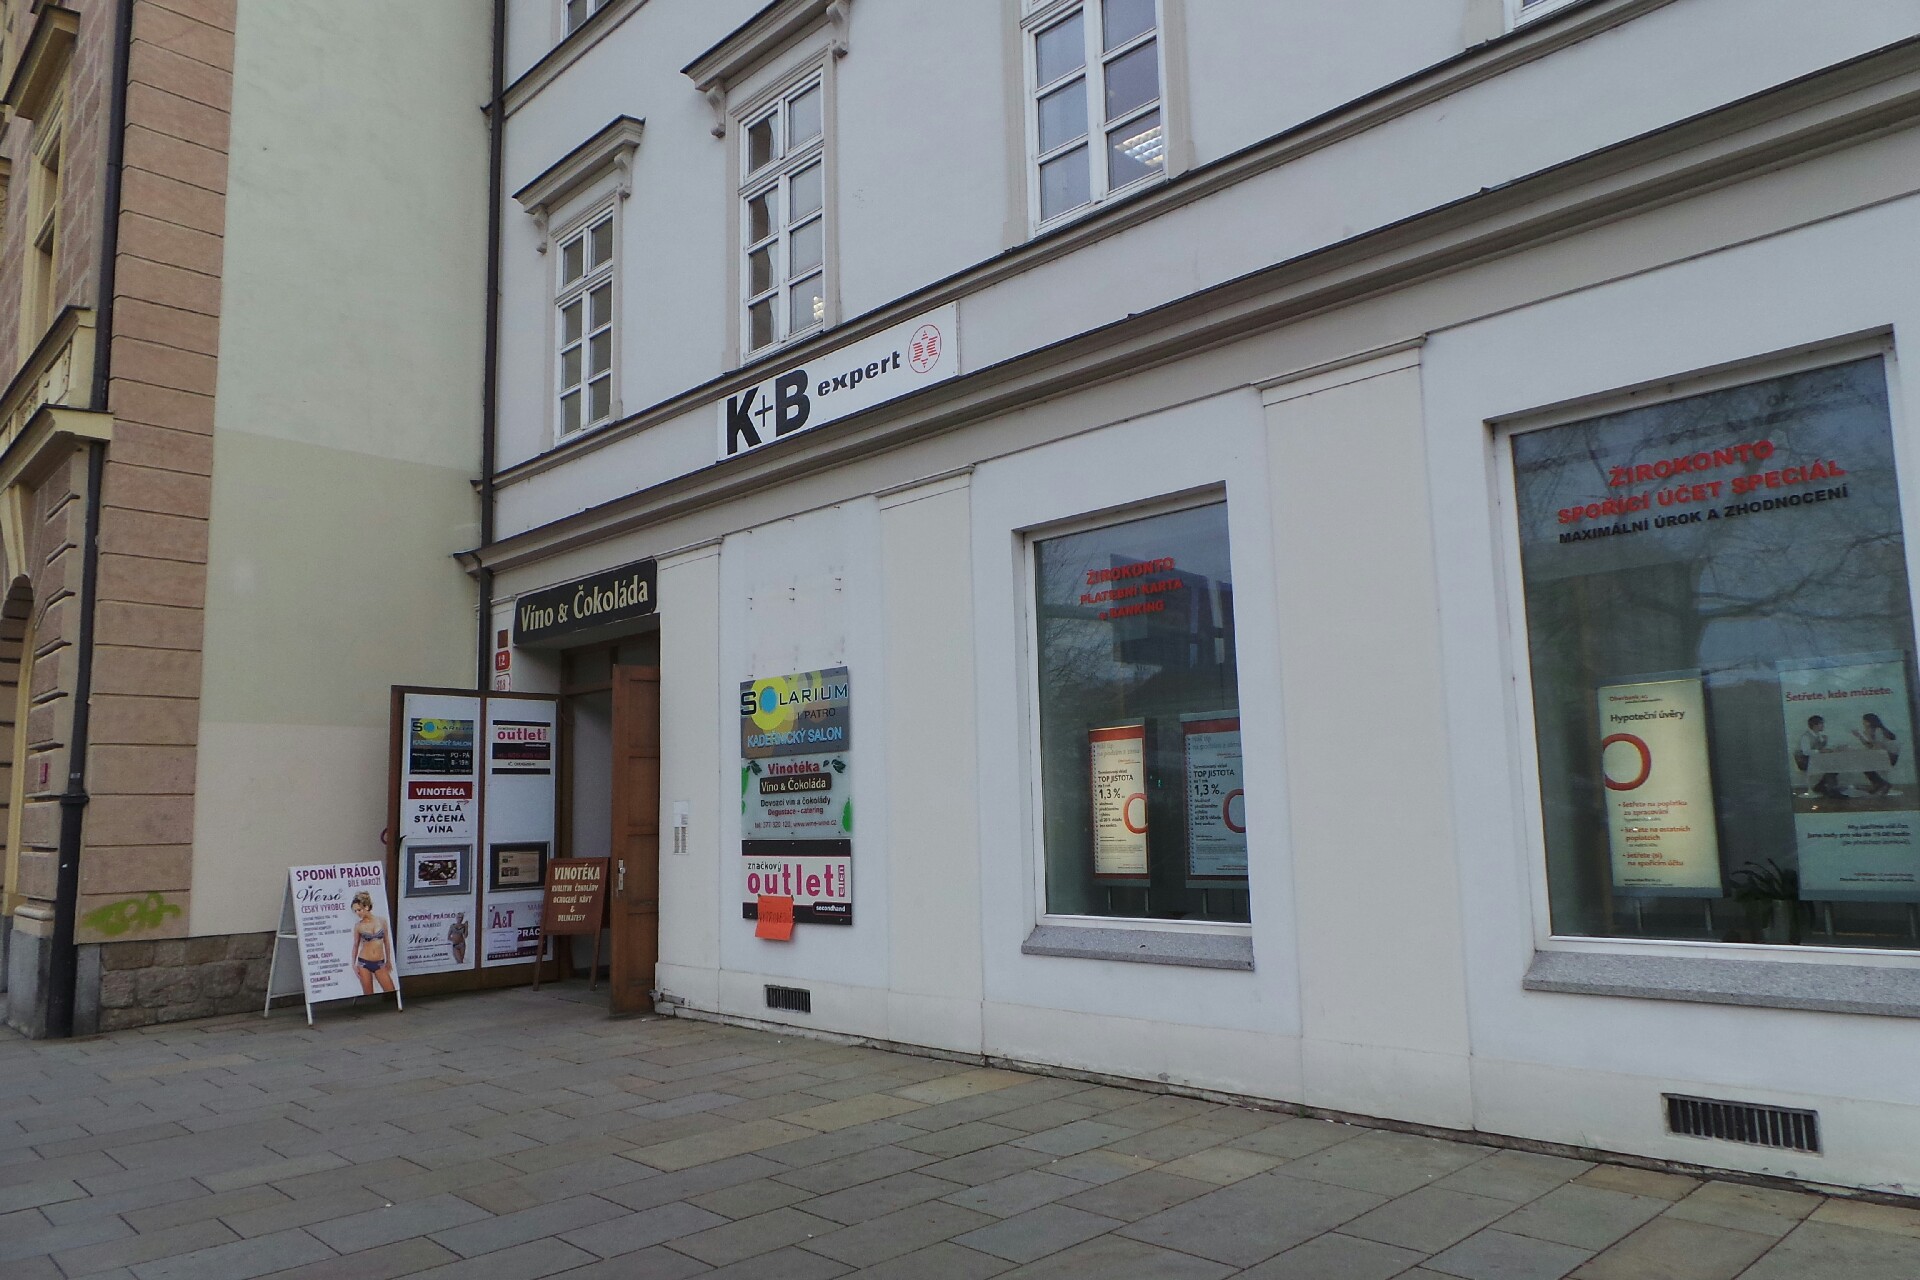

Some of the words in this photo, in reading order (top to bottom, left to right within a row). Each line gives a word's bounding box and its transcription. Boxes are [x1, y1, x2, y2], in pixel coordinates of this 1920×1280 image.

[726, 369, 811, 456] K+B
[817, 351, 901, 397] expert
[1608, 439, 1775, 488] ŽIROKONTO
[1557, 492, 1650, 525] SPOŘÍCÍ
[1657, 480, 1723, 507] ÚČET
[1731, 458, 1847, 495] SPECIÁL
[1559, 516, 1649, 544] MAXIMÁLNÍ
[1654, 510, 1701, 529] ÚROK
[1706, 508, 1719, 520] A
[1724, 483, 1849, 517] ZHODNOCENÍ
[1086, 556, 1175, 585] ŽIROKONTO
[1080, 583, 1137, 605] PLATEBNÍ
[1141, 578, 1184, 594] KARTA
[521, 604, 554, 632] Víno
[557, 603, 569, 623] &
[573, 575, 649, 619] Čokoláda
[740, 684, 848, 716] SOLARIUM
[804, 708, 836, 719] PATRO
[1610, 711, 1657, 724] Hypoteční
[1658, 709, 1685, 720] úvěry
[497, 727, 542, 740] outlet
[747, 727, 806, 748] KADEŘNICKÝ
[807, 726, 842, 744] SALON
[768, 761, 820, 775] Vinotéka
[1193, 769, 1207, 778] TOP
[1208, 769, 1235, 779] JISTOTA
[761, 780, 779, 792] Víno
[787, 777, 826, 790] Čokoláda
[1098, 775, 1111, 783] TOP
[1110, 774, 1134, 784] JISTOTA
[416, 786, 465, 797] VINOTÉKA
[1098, 788, 1112, 800] 1,3
[1113, 788, 1121, 799] %
[1194, 784, 1209, 797] 1,3
[1211, 783, 1220, 795] %
[418, 802, 462, 812] SKVĚLÁ
[760, 798, 785, 807] Dovozci
[802, 795, 831, 806] čokolády
[414, 812, 466, 823] STÁČENÁ
[767, 808, 796, 817] Degustace
[800, 806, 824, 814] catering
[426, 824, 454, 833] VÍNA
[296, 865, 337, 882] SPODNÍ
[340, 863, 381, 879] PRÁDLO
[554, 863, 601, 880] VINOTÉKA
[747, 861, 782, 872] značkový
[747, 863, 834, 897] outlet
[815, 904, 846, 912] secondhand
[492, 910, 514, 928] A&T
[518, 926, 540, 937] PRÁC
